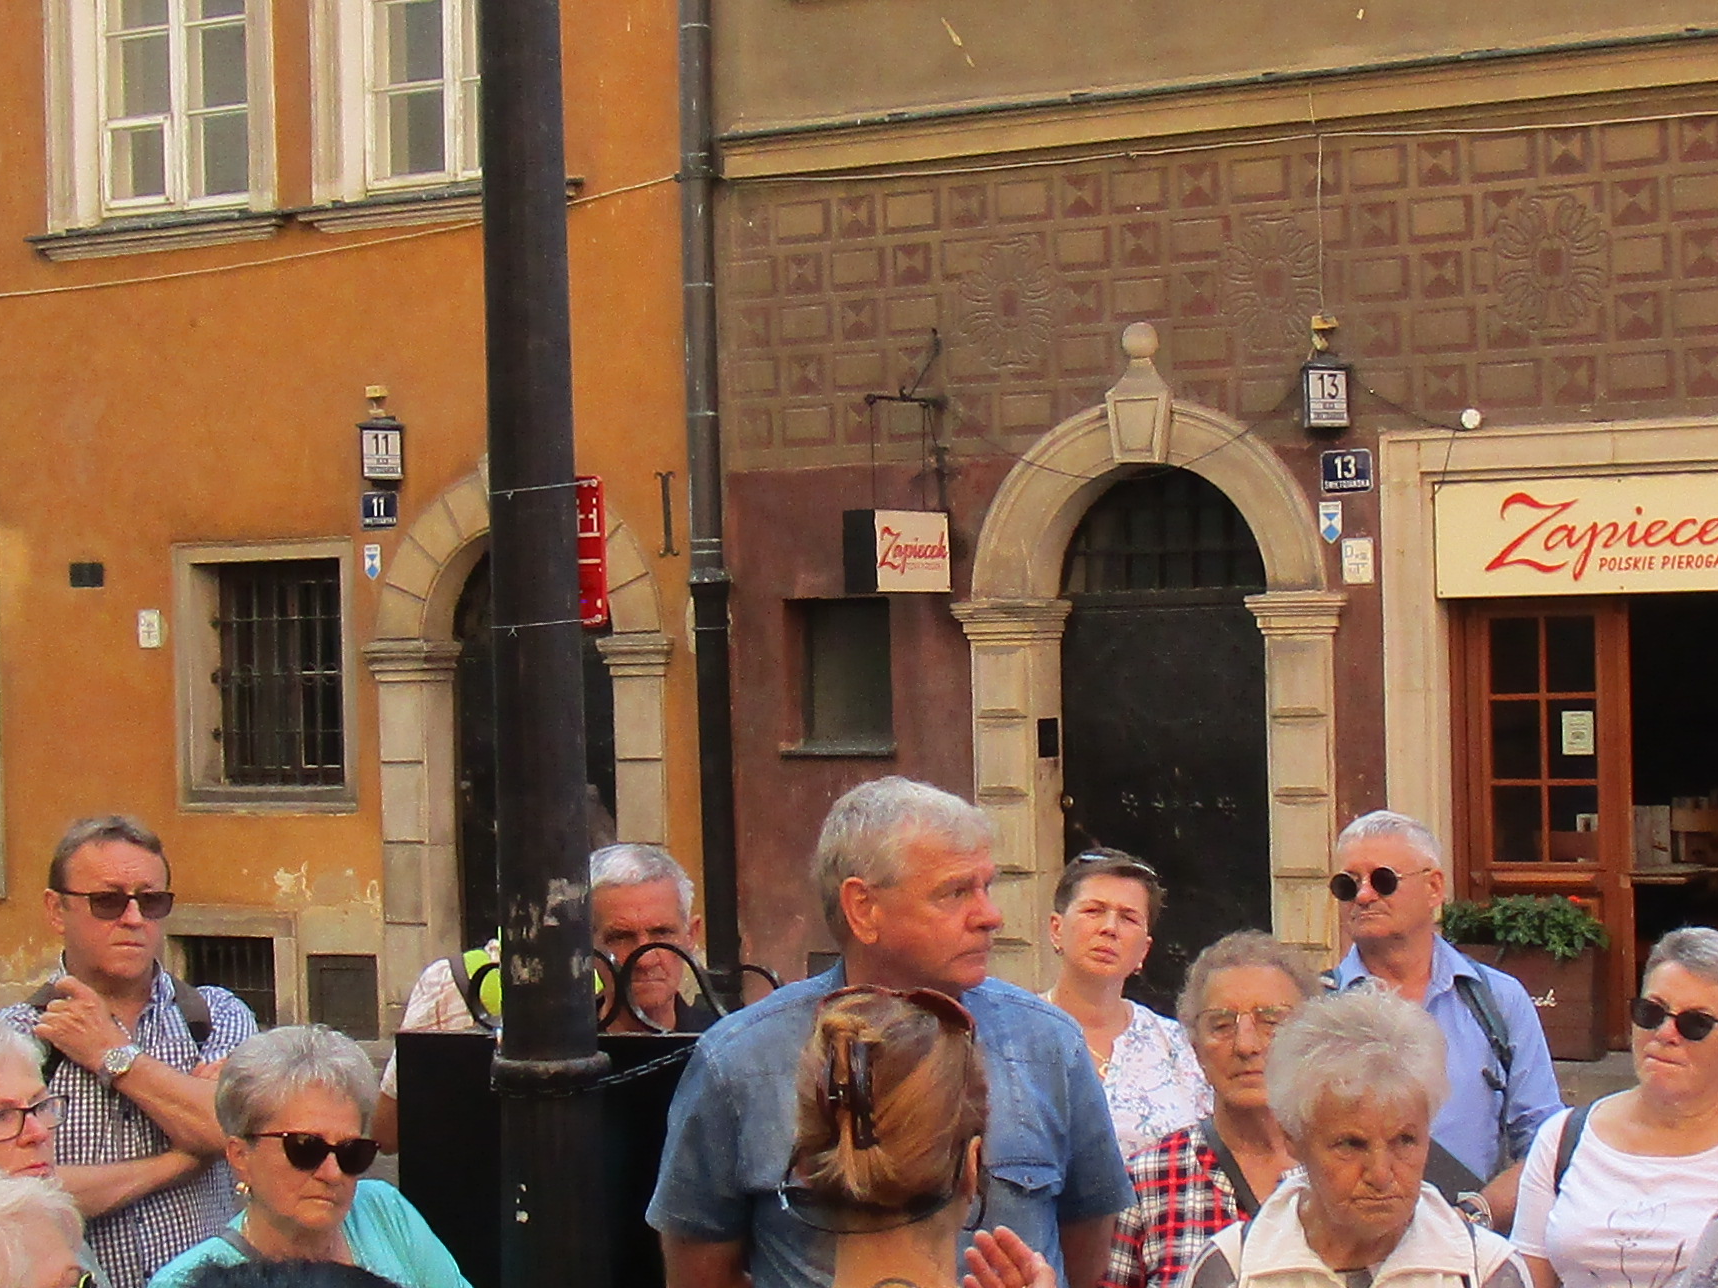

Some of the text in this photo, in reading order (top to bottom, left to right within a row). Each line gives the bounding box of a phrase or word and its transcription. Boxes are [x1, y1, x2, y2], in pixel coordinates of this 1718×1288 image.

[1318, 374, 1339, 399] 13
[372, 433, 389, 455] 11
[1334, 455, 1356, 479] 13
[372, 496, 385, 517] 11
[878, 526, 949, 575] Zapiecek
[1598, 556, 1656, 572] POLSKIE
